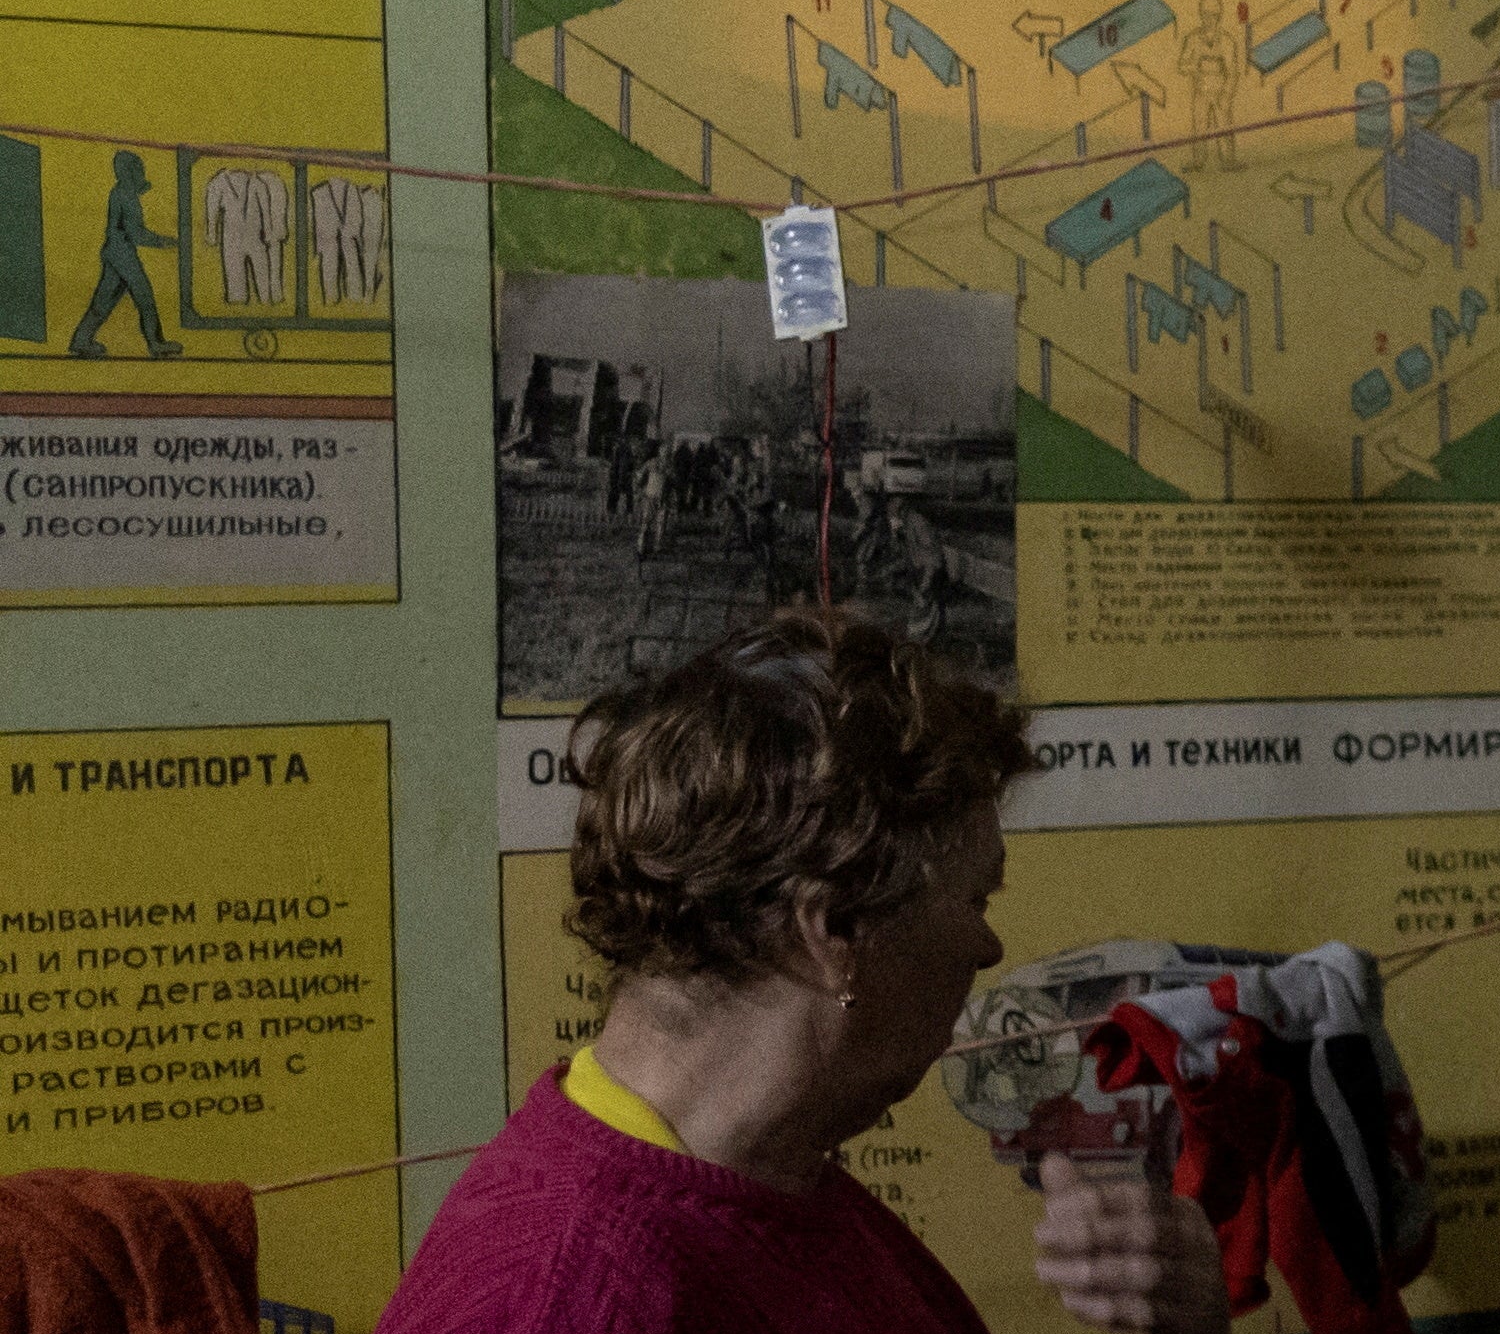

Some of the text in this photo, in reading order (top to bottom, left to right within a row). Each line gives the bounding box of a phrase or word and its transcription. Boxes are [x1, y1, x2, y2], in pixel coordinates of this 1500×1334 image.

[1130, 739, 1152, 769] И
[9, 751, 312, 795] И ТРАНСПОРТА
